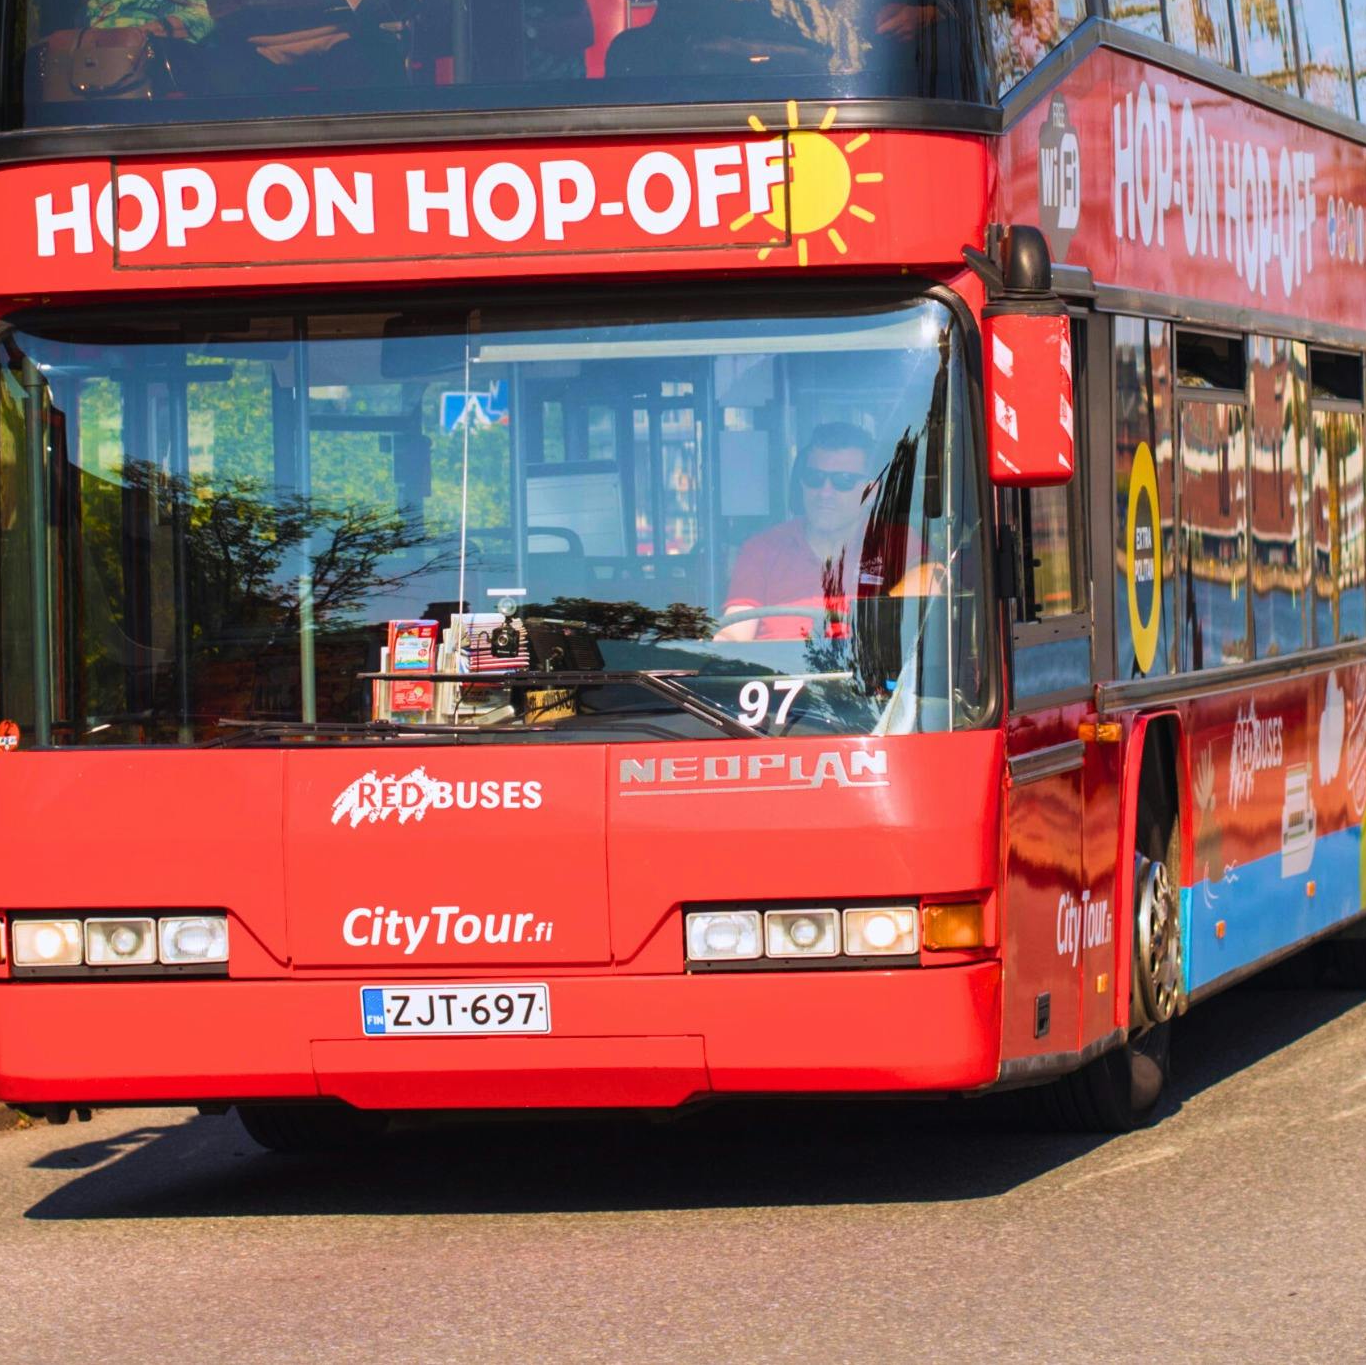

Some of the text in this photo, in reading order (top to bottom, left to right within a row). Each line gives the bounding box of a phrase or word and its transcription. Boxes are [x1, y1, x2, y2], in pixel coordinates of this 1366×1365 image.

[35, 141, 794, 256] HOP-ON HOP-OFF
[1114, 81, 1317, 298] HOP-ON HOP-OFF
[737, 679, 804, 727] 97
[619, 750, 888, 788] NEOPLAN
[366, 993, 536, 1026] FIN ZJT-697
